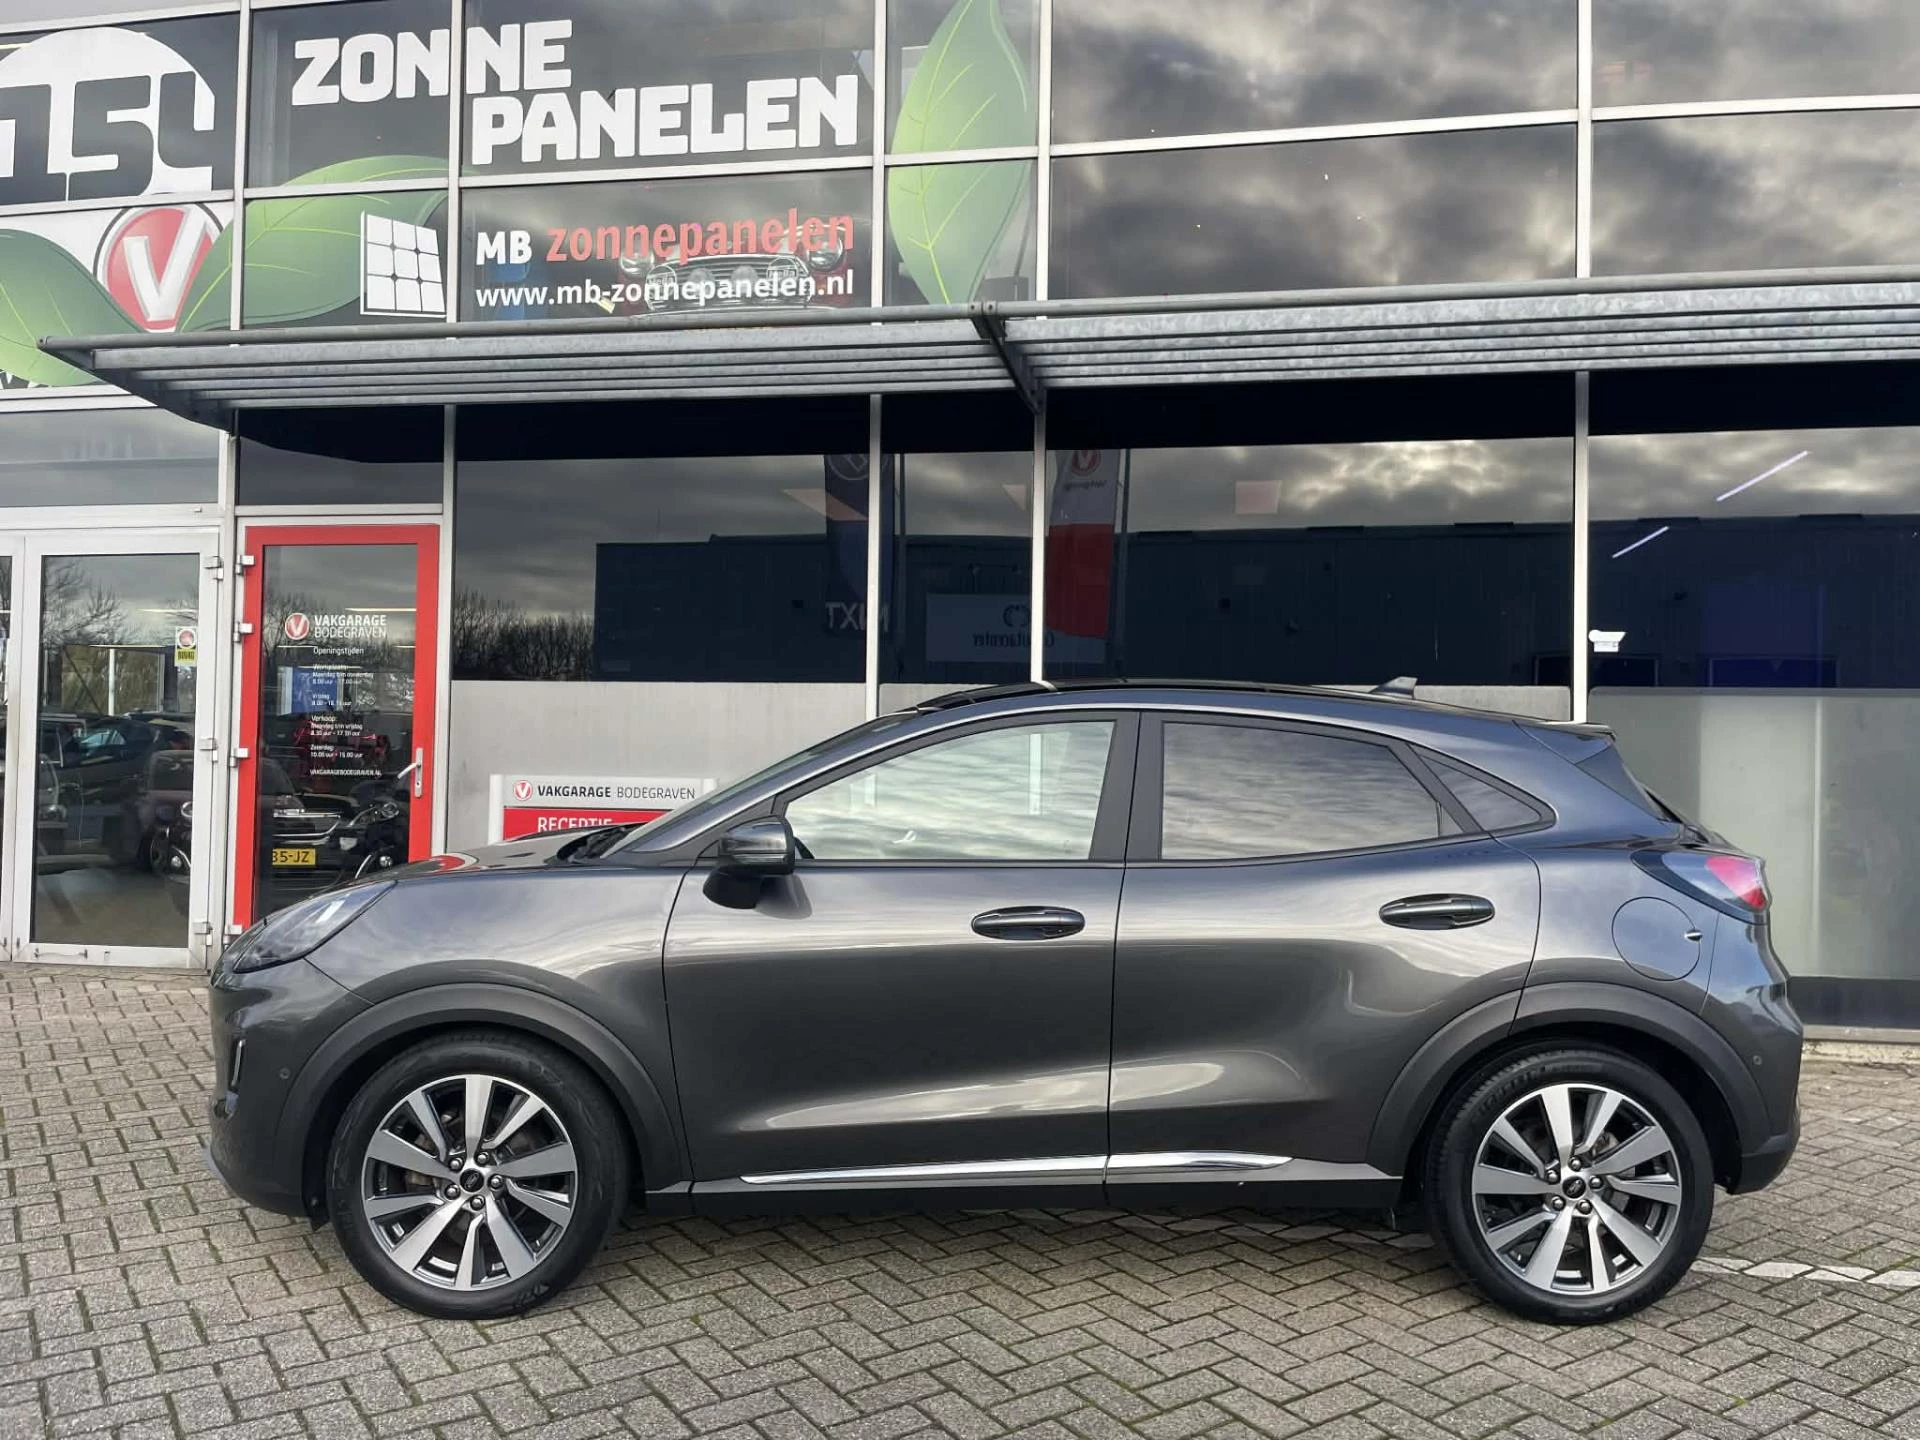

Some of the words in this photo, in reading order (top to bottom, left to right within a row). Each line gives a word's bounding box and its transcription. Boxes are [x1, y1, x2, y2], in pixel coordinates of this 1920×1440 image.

[292, 19, 572, 106] ZONNE
[472, 75, 858, 165] PANELEN
[476, 230, 532, 265] MB
[546, 208, 854, 265] zonnepanelen
[476, 269, 853, 307] www.mb-zonnepanelen.nl
[314, 615, 387, 626] VAKGARAGE
[314, 627, 387, 639] BODEGRAVEN
[537, 785, 611, 798] VAKGARAGE
[617, 787, 696, 800] BODEGRAVEN
